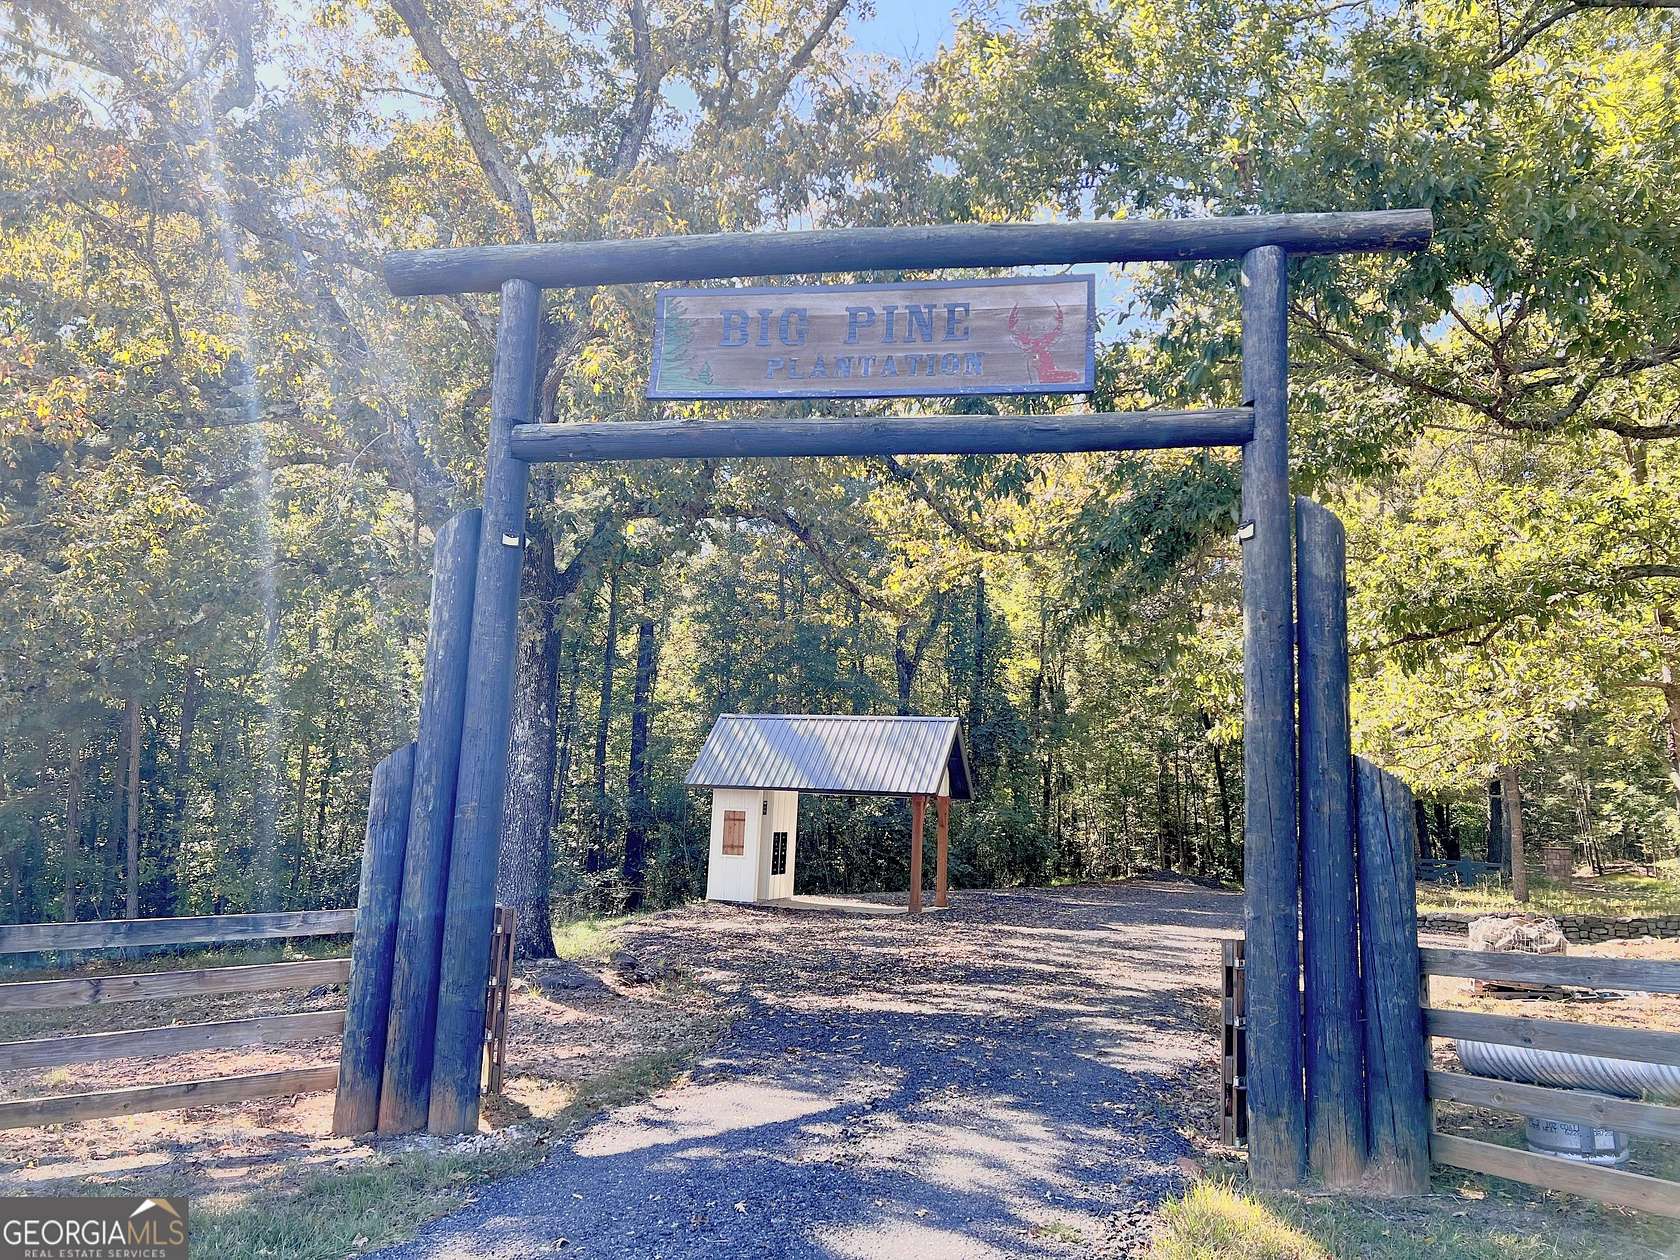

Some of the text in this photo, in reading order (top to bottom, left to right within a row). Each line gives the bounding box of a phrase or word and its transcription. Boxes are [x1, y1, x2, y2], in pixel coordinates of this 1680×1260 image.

[719, 303, 972, 347] BIG PINE
[766, 352, 985, 379] PLANTATION
